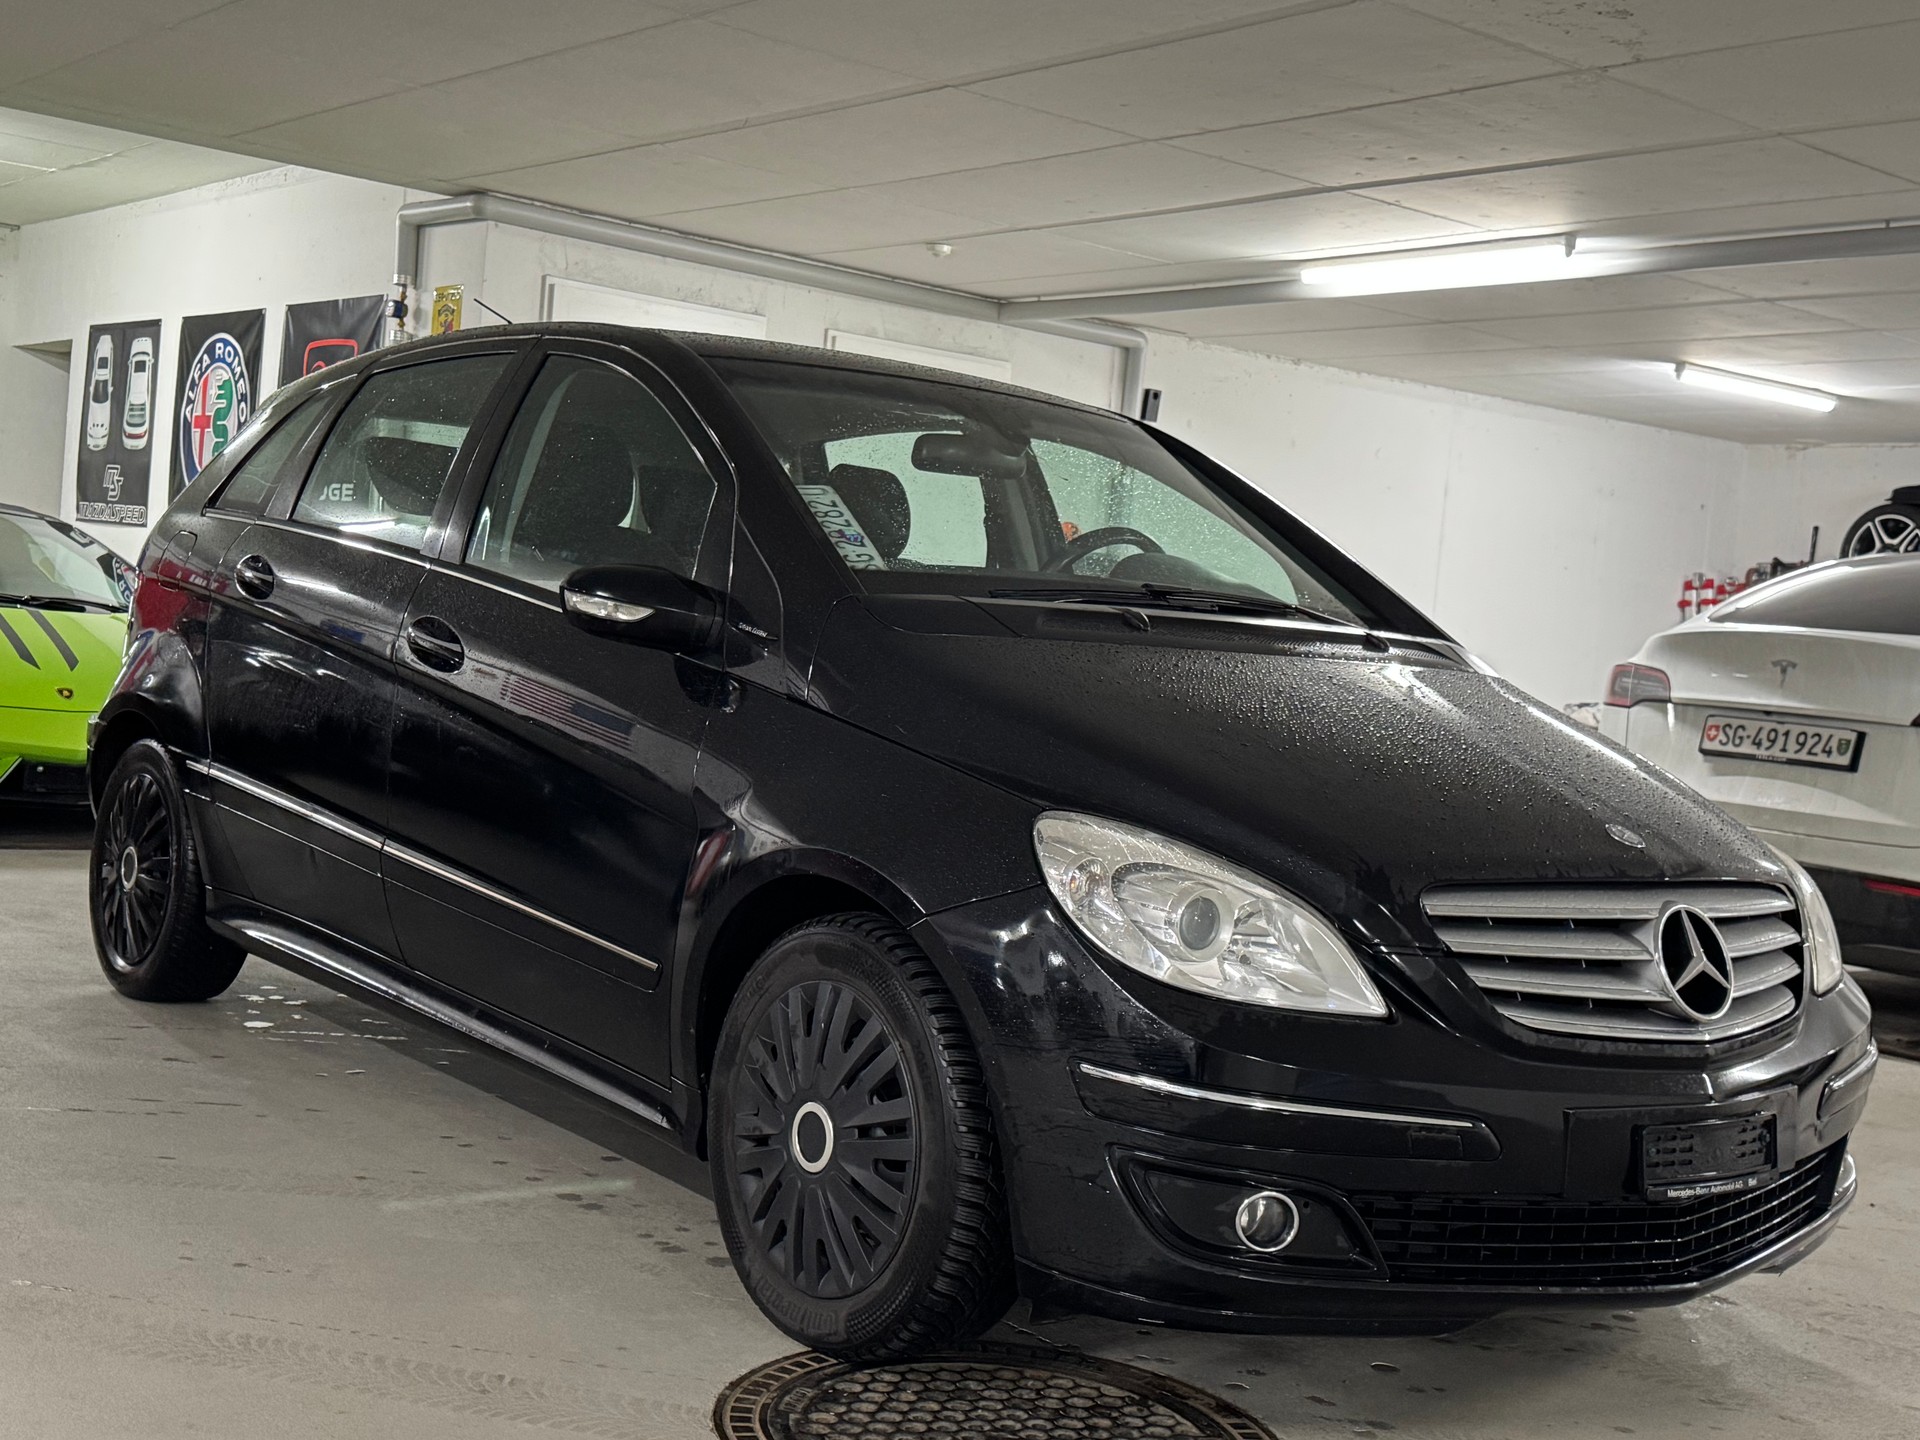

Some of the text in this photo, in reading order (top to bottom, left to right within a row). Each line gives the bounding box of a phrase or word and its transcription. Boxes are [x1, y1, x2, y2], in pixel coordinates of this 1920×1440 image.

[185, 342, 247, 423] ALFA ROMEO
[79, 501, 147, 524] MAZDASPEED
[1667, 1186, 1710, 1199] Mercedes-Benz
